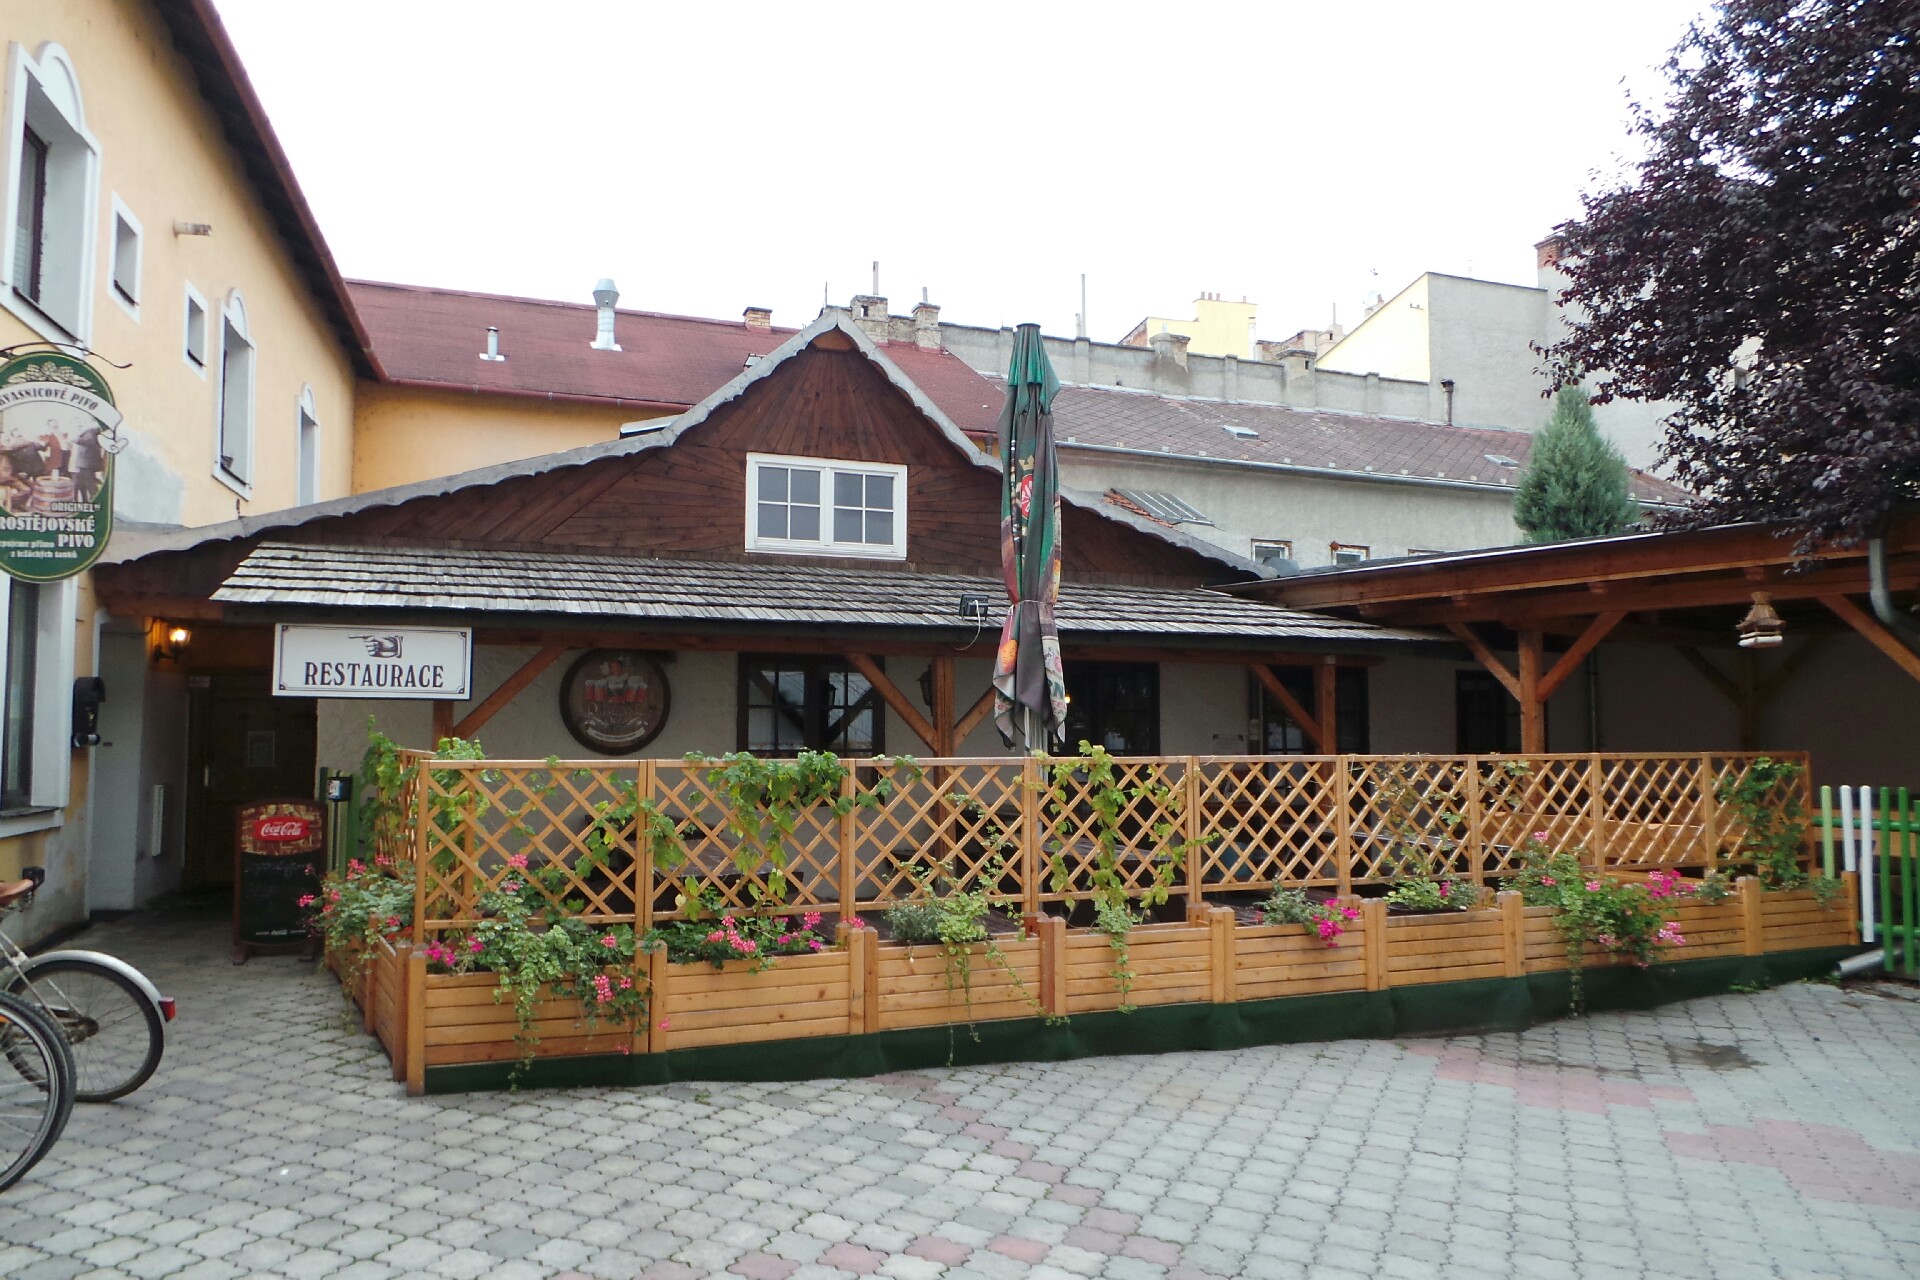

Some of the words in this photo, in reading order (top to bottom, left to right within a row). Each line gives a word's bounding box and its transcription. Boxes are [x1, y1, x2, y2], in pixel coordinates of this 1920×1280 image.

[71, 392, 99, 411] PIVO
[57, 533, 95, 548] PIVO
[304, 661, 444, 688] RESTAURACE
